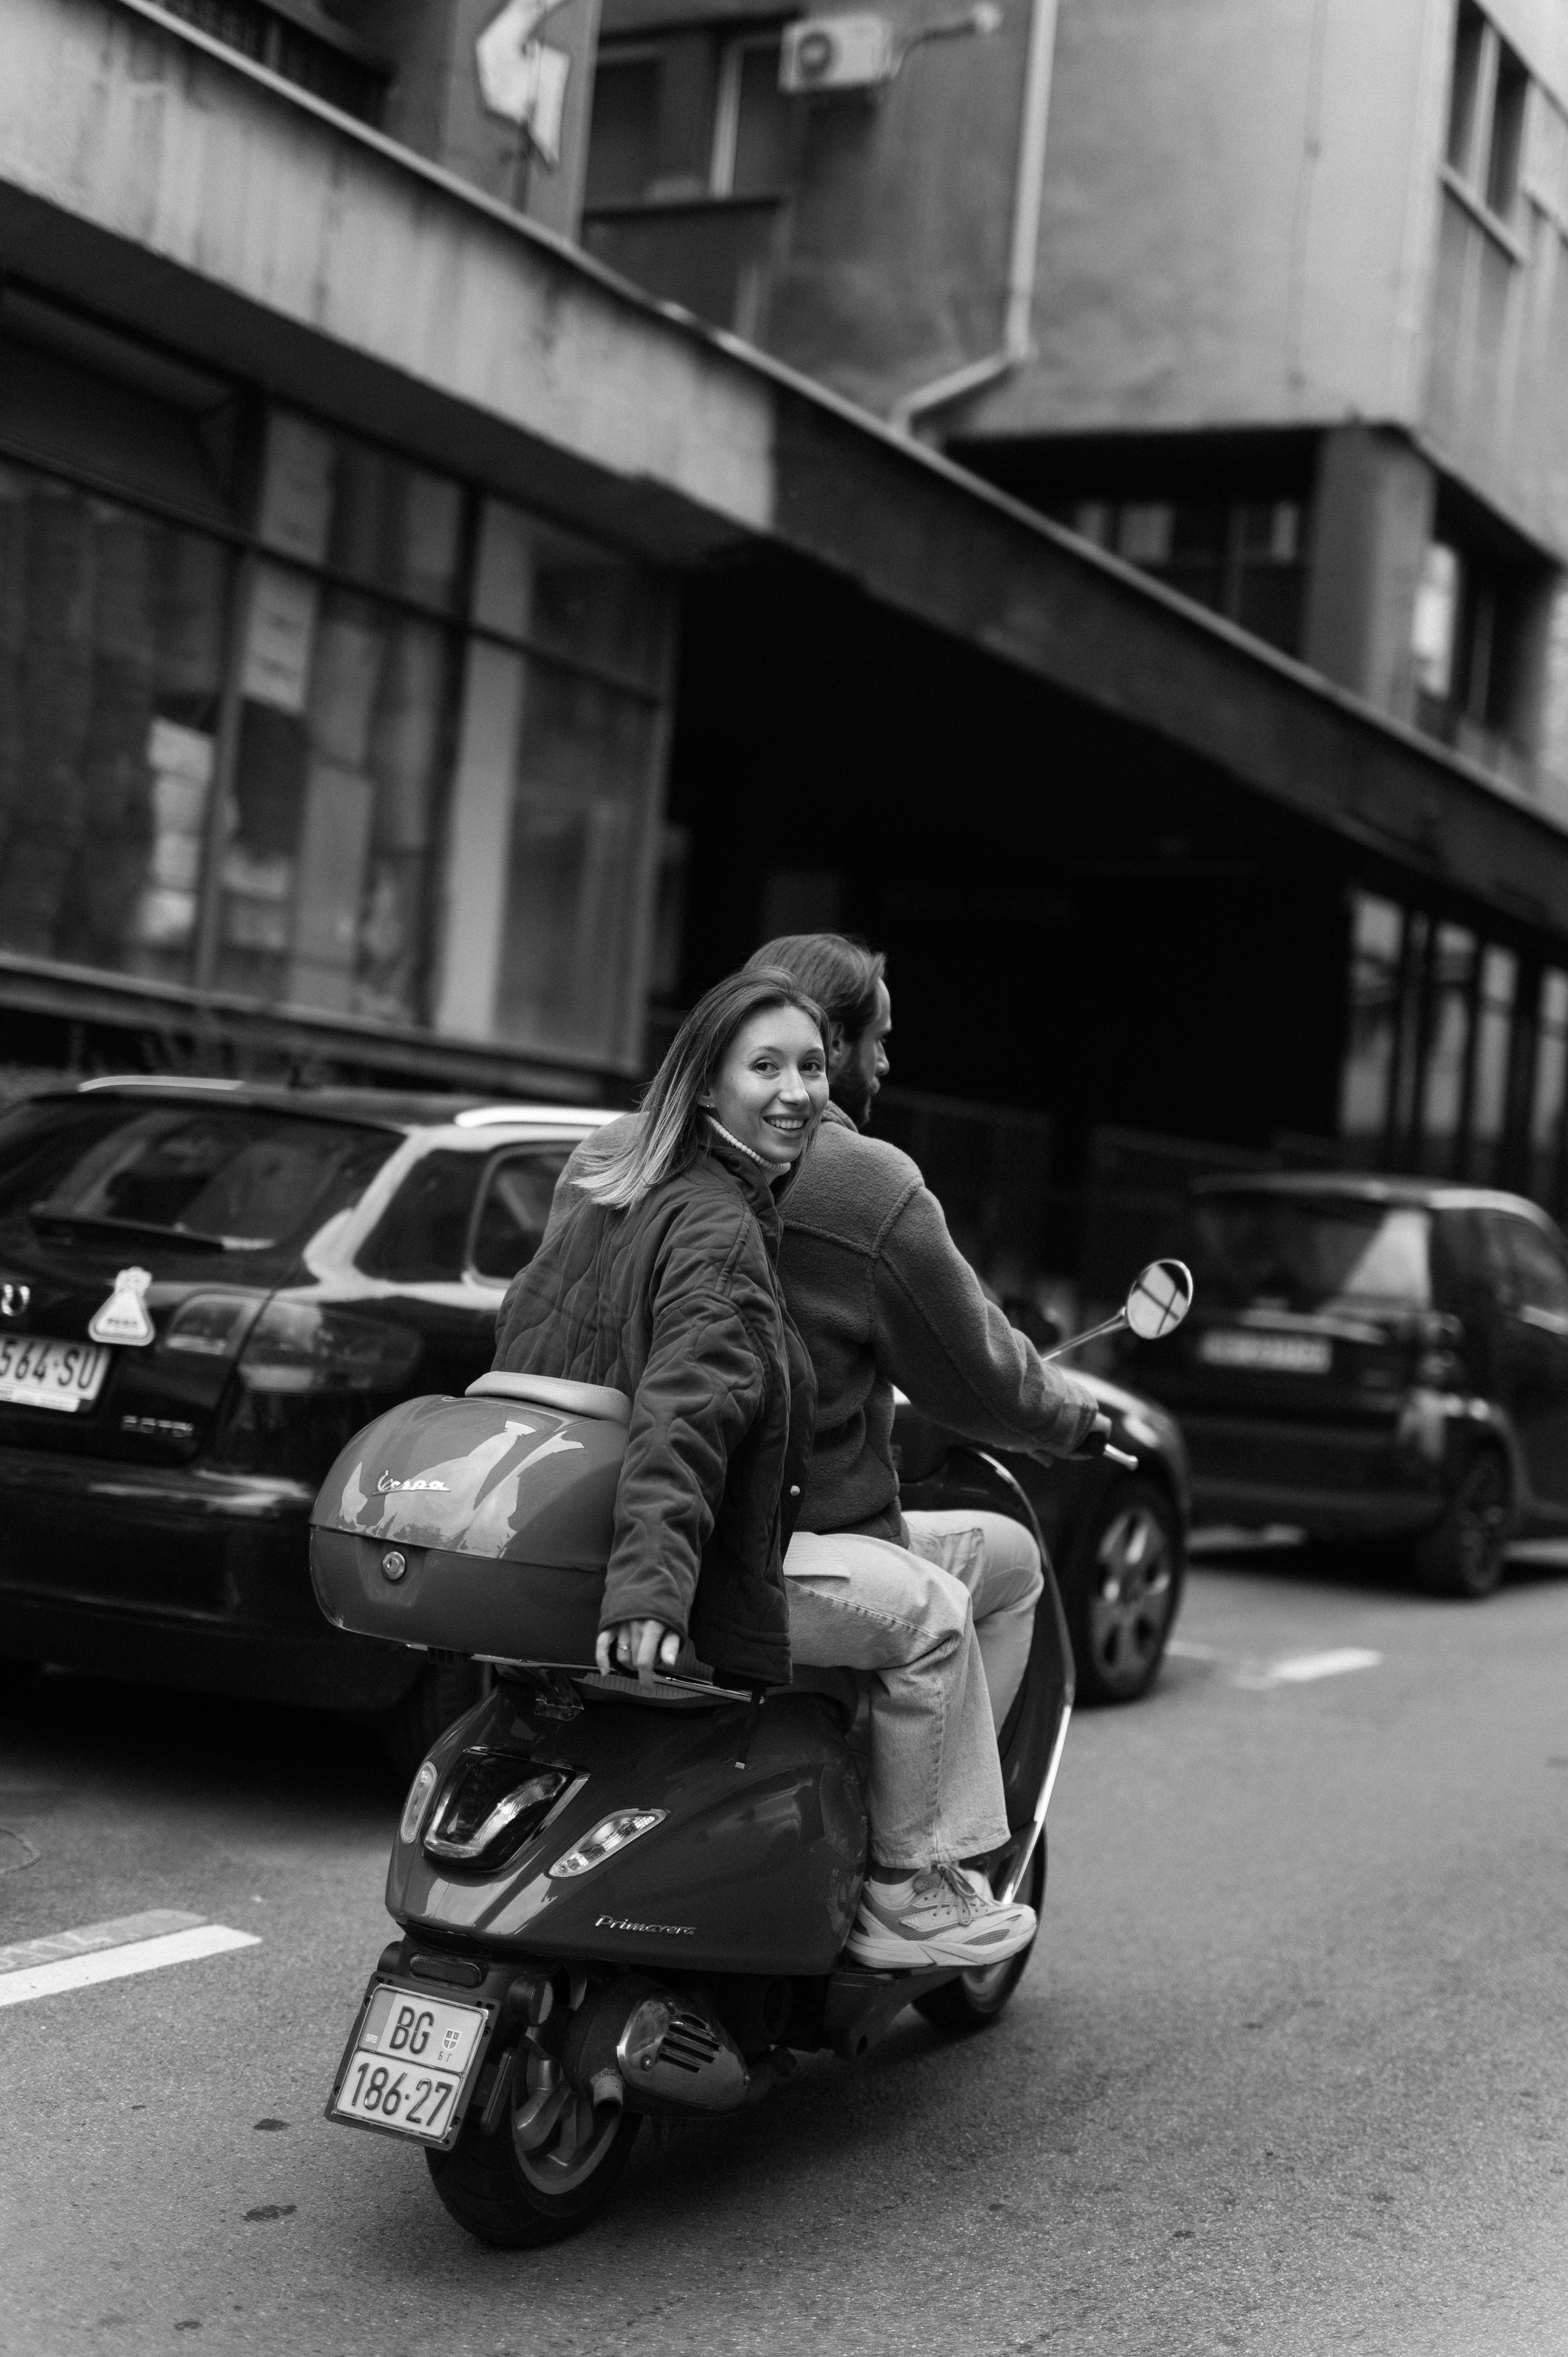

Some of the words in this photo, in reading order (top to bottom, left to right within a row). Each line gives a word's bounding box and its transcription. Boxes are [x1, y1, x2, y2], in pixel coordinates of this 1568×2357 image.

[372, 1470, 451, 1495] Vespa
[594, 1914, 696, 1935] Primavera
[366, 2033, 378, 2044] SRB
[390, 2005, 435, 2054] BG
